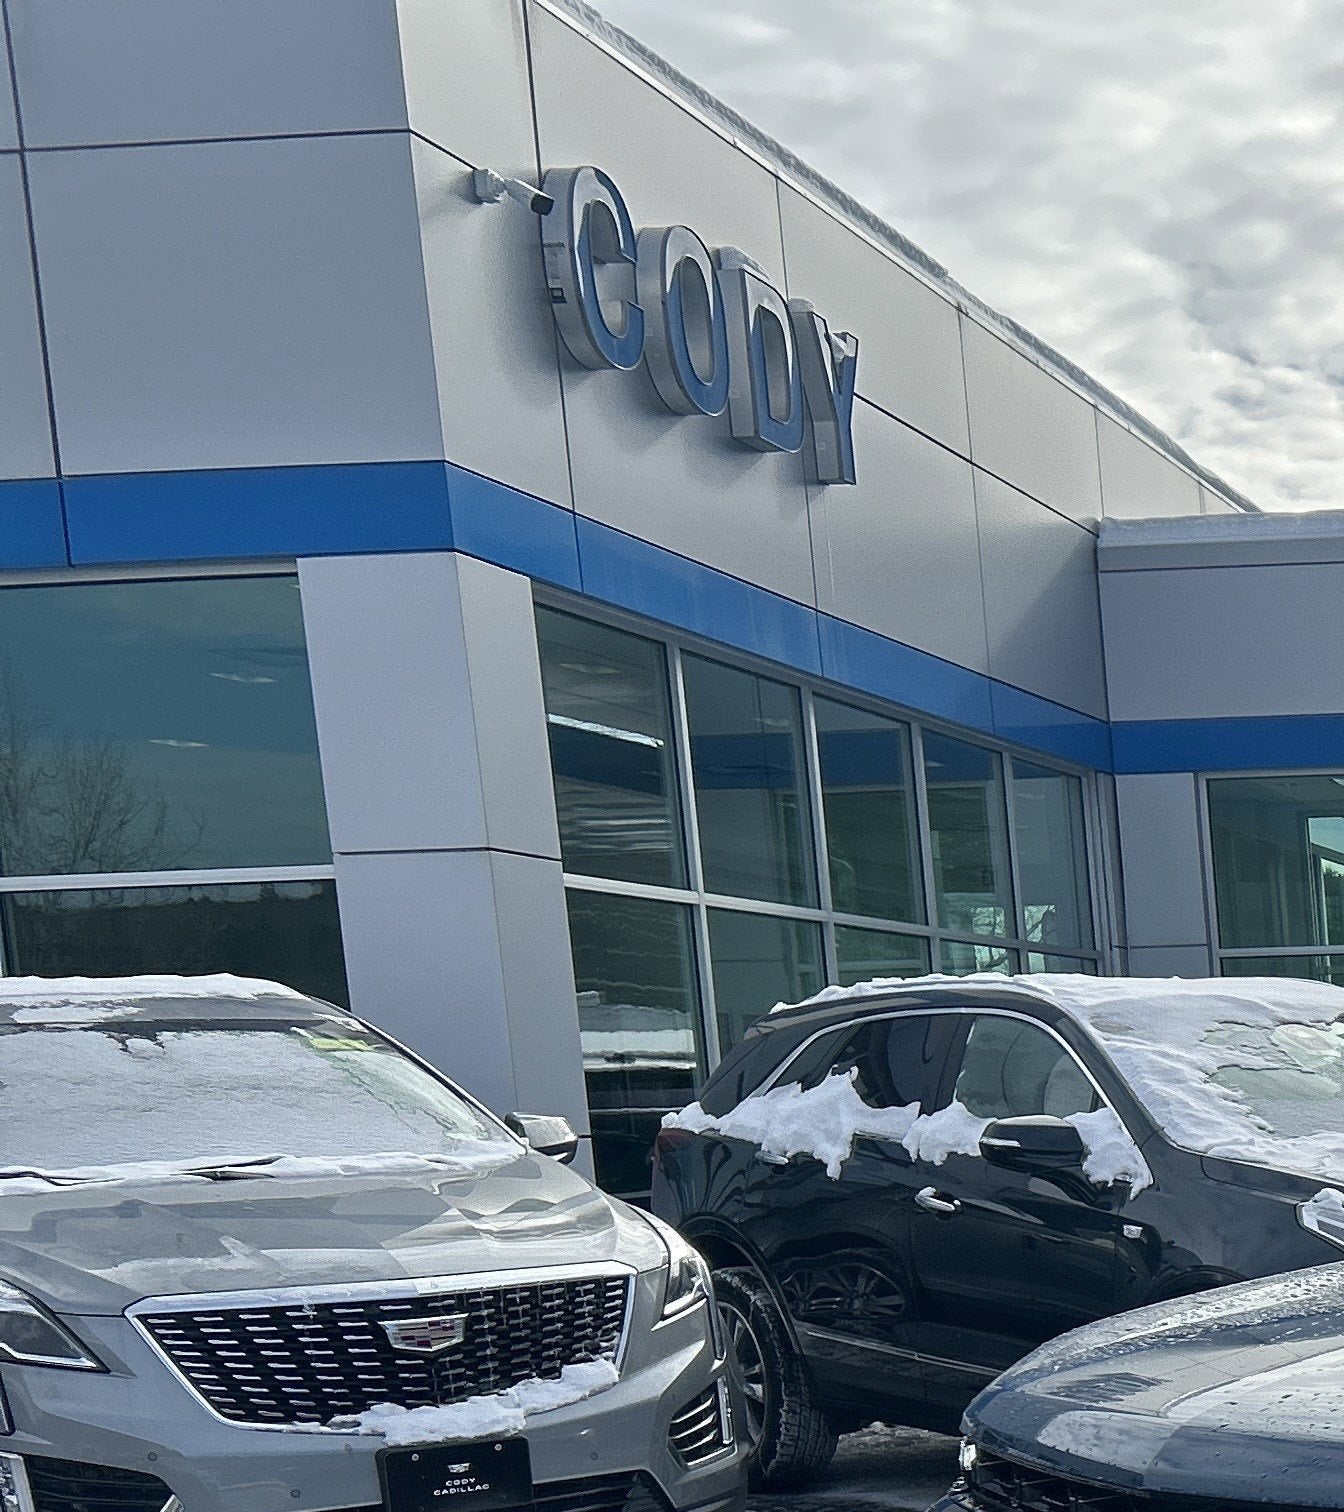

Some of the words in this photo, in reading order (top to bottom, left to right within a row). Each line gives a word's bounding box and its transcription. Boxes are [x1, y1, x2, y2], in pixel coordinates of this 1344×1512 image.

[541, 166, 858, 485] CODY
[445, 1477, 475, 1487] CODY
[433, 1483, 489, 1495] CADILLAC
